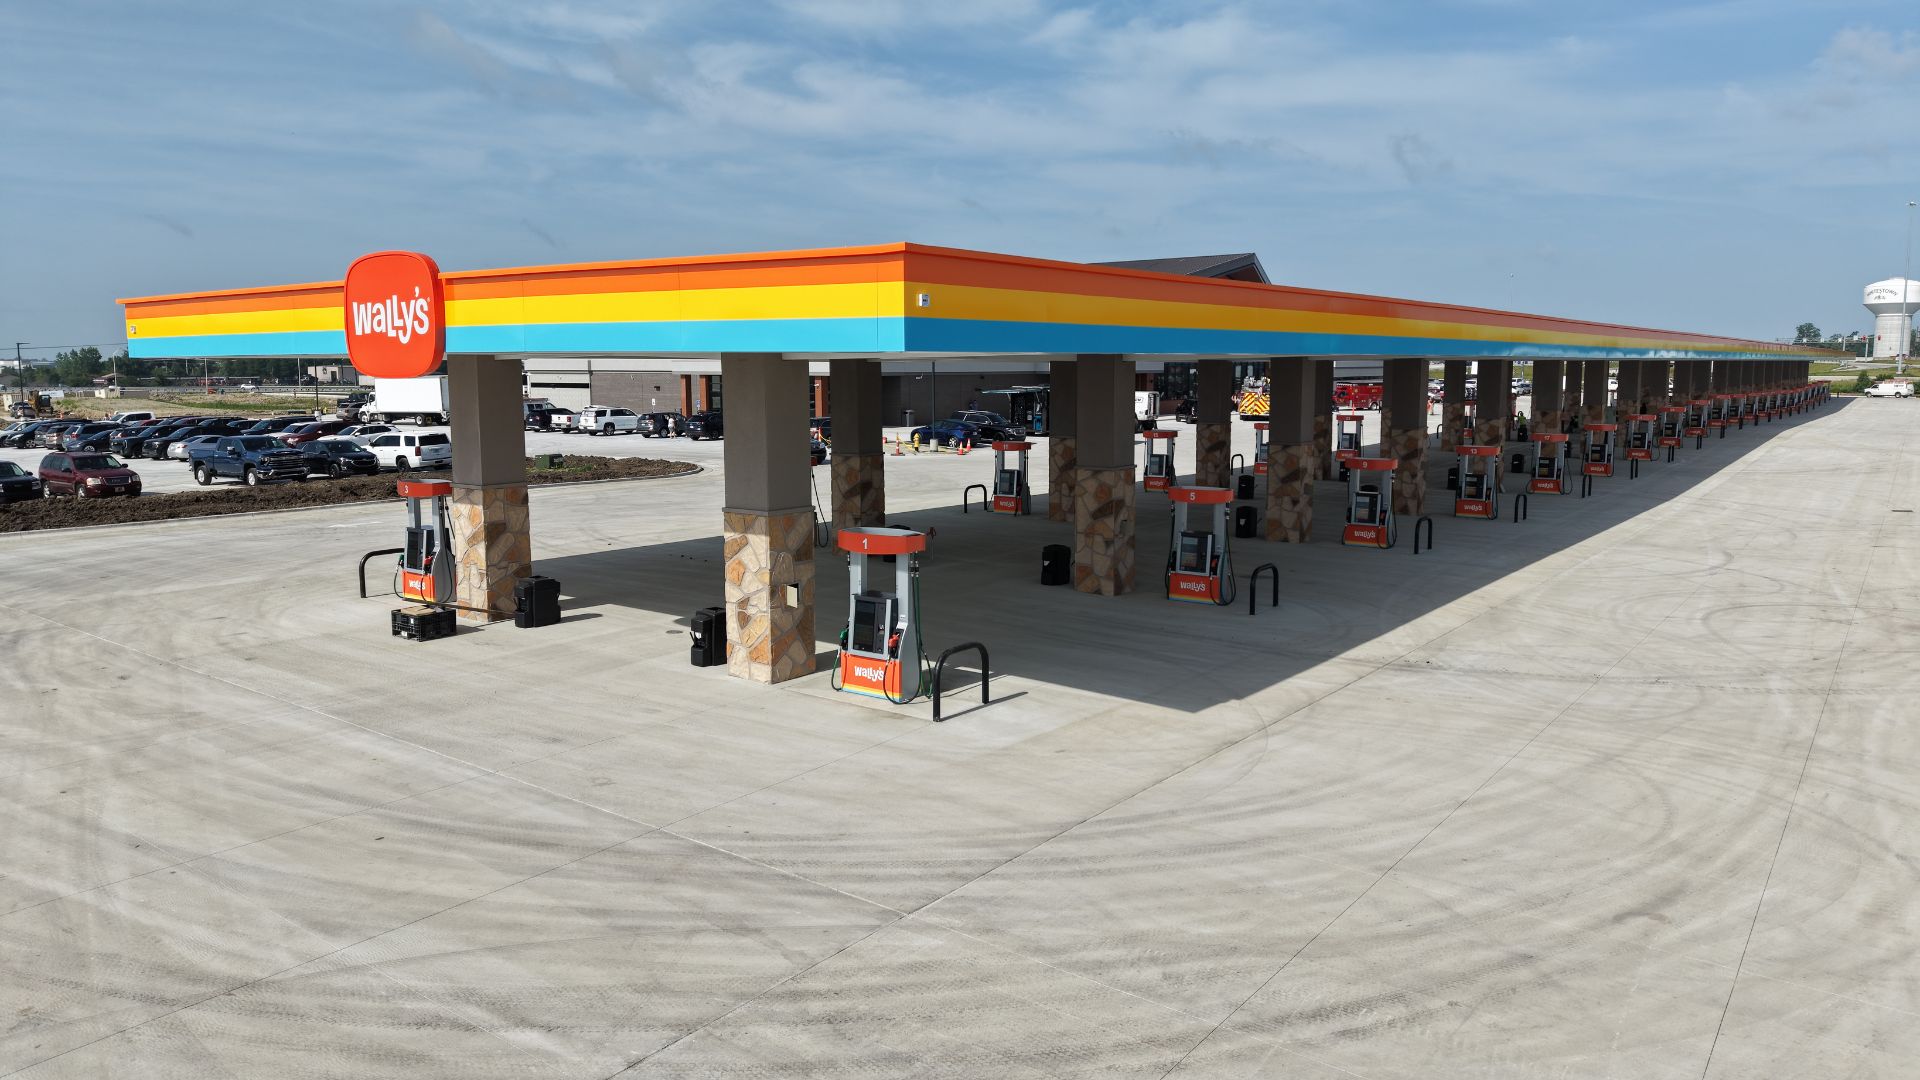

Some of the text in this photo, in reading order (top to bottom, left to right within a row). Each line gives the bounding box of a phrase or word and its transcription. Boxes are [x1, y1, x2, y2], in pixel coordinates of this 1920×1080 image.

[404, 485, 409, 494] 3
[1189, 492, 1196, 501] 5
[862, 538, 868, 549] 1
